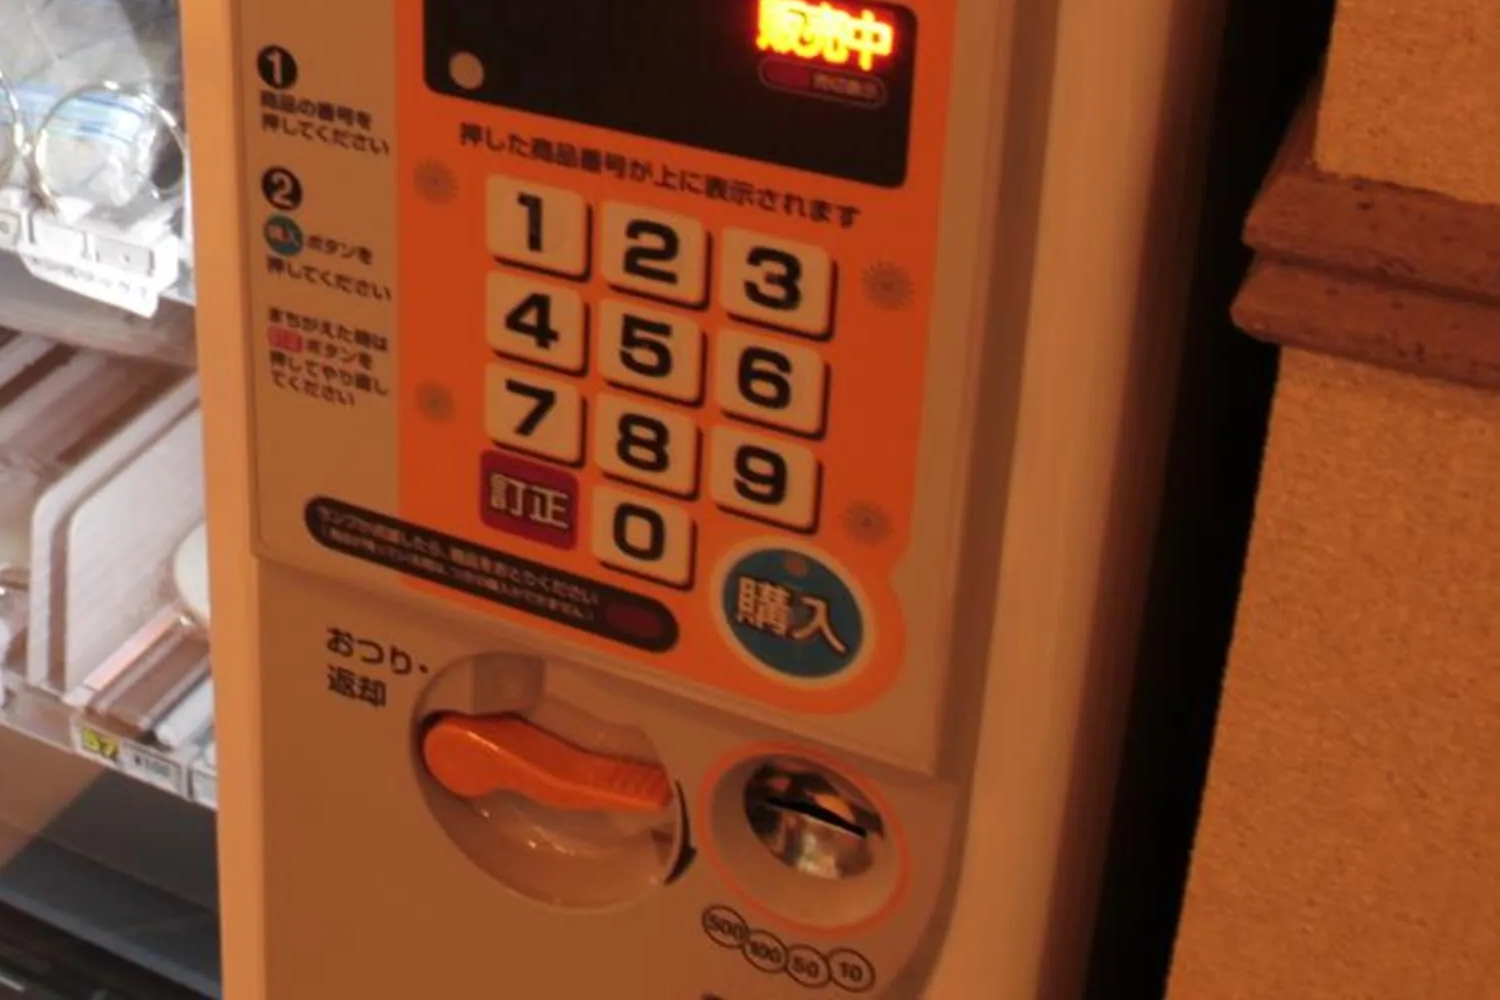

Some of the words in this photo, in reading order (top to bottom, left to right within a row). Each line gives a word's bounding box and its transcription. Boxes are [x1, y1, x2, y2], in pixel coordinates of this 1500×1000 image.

[261, 111, 390, 156] 押してください
[460, 121, 861, 229] 押した商品番号が上に表示されます
[307, 234, 373, 266] ボタンを
[517, 191, 545, 253] 1
[624, 221, 681, 285] 2
[743, 247, 803, 311] 3
[267, 254, 392, 302] 押してください
[505, 292, 561, 350] 4
[619, 315, 675, 378] 5
[738, 347, 793, 410] 6
[271, 369, 356, 406] てください
[505, 379, 558, 439] 7
[615, 412, 670, 473] 8
[734, 444, 788, 505] 9
[489, 472, 570, 531] 訂正
[612, 504, 667, 562] 0
[736, 576, 847, 656] 購入
[326, 663, 388, 709] 返却
[704, 912, 745, 941] 500
[791, 956, 821, 979] 50
[839, 960, 864, 983] 10
